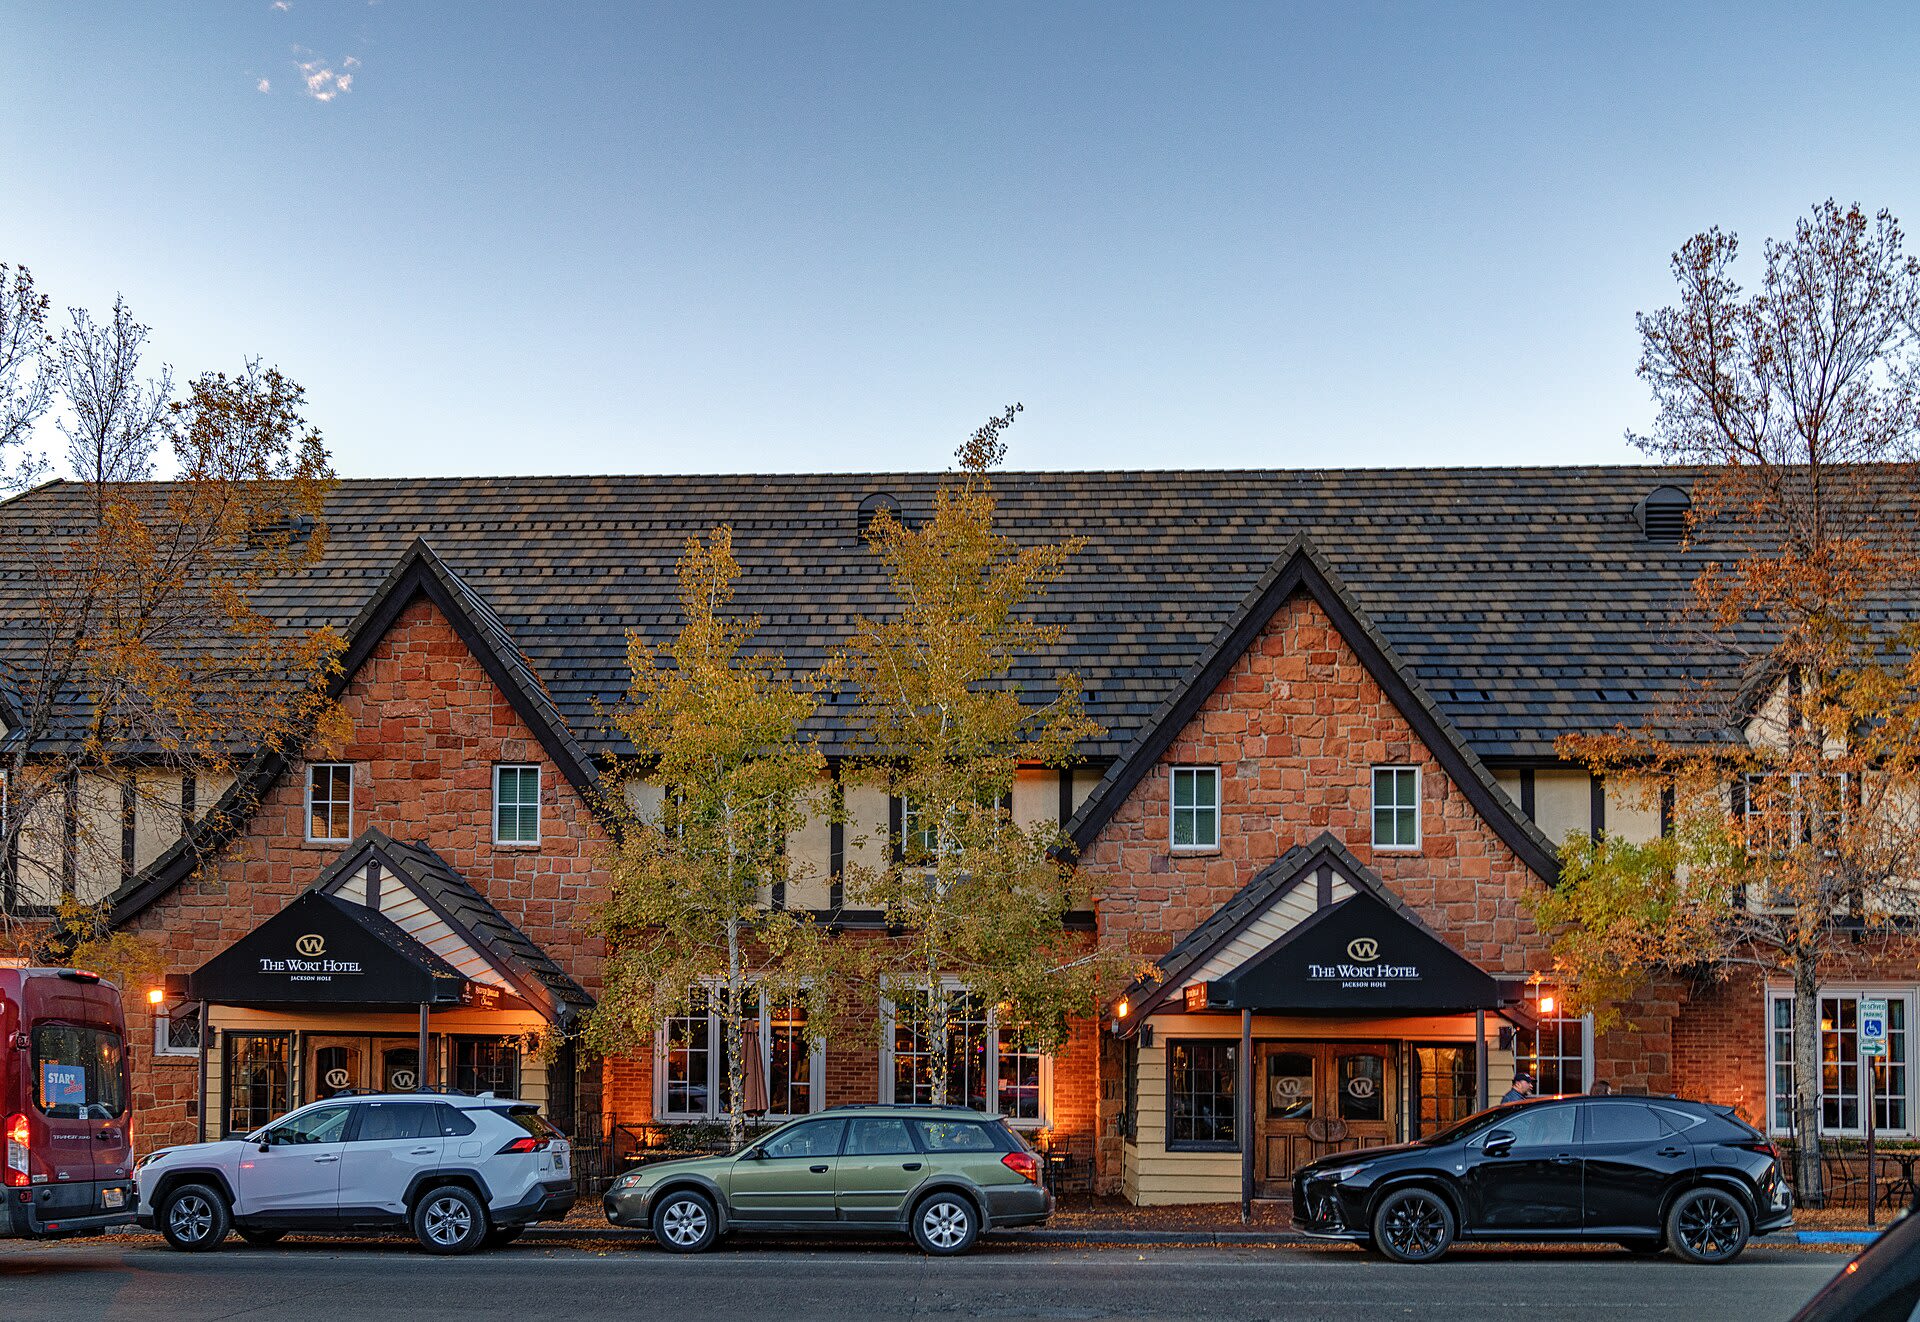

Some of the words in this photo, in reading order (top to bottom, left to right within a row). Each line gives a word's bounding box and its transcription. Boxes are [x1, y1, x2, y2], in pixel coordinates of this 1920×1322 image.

[260, 959, 285, 971] THE
[286, 959, 321, 972] WORT
[323, 960, 362, 972] HOTEL
[1308, 964, 1335, 978] THE
[1337, 964, 1375, 978] WORT
[1377, 964, 1420, 978] HOTEL
[1342, 981, 1369, 989] JACKSON
[48, 1072, 75, 1084] START
